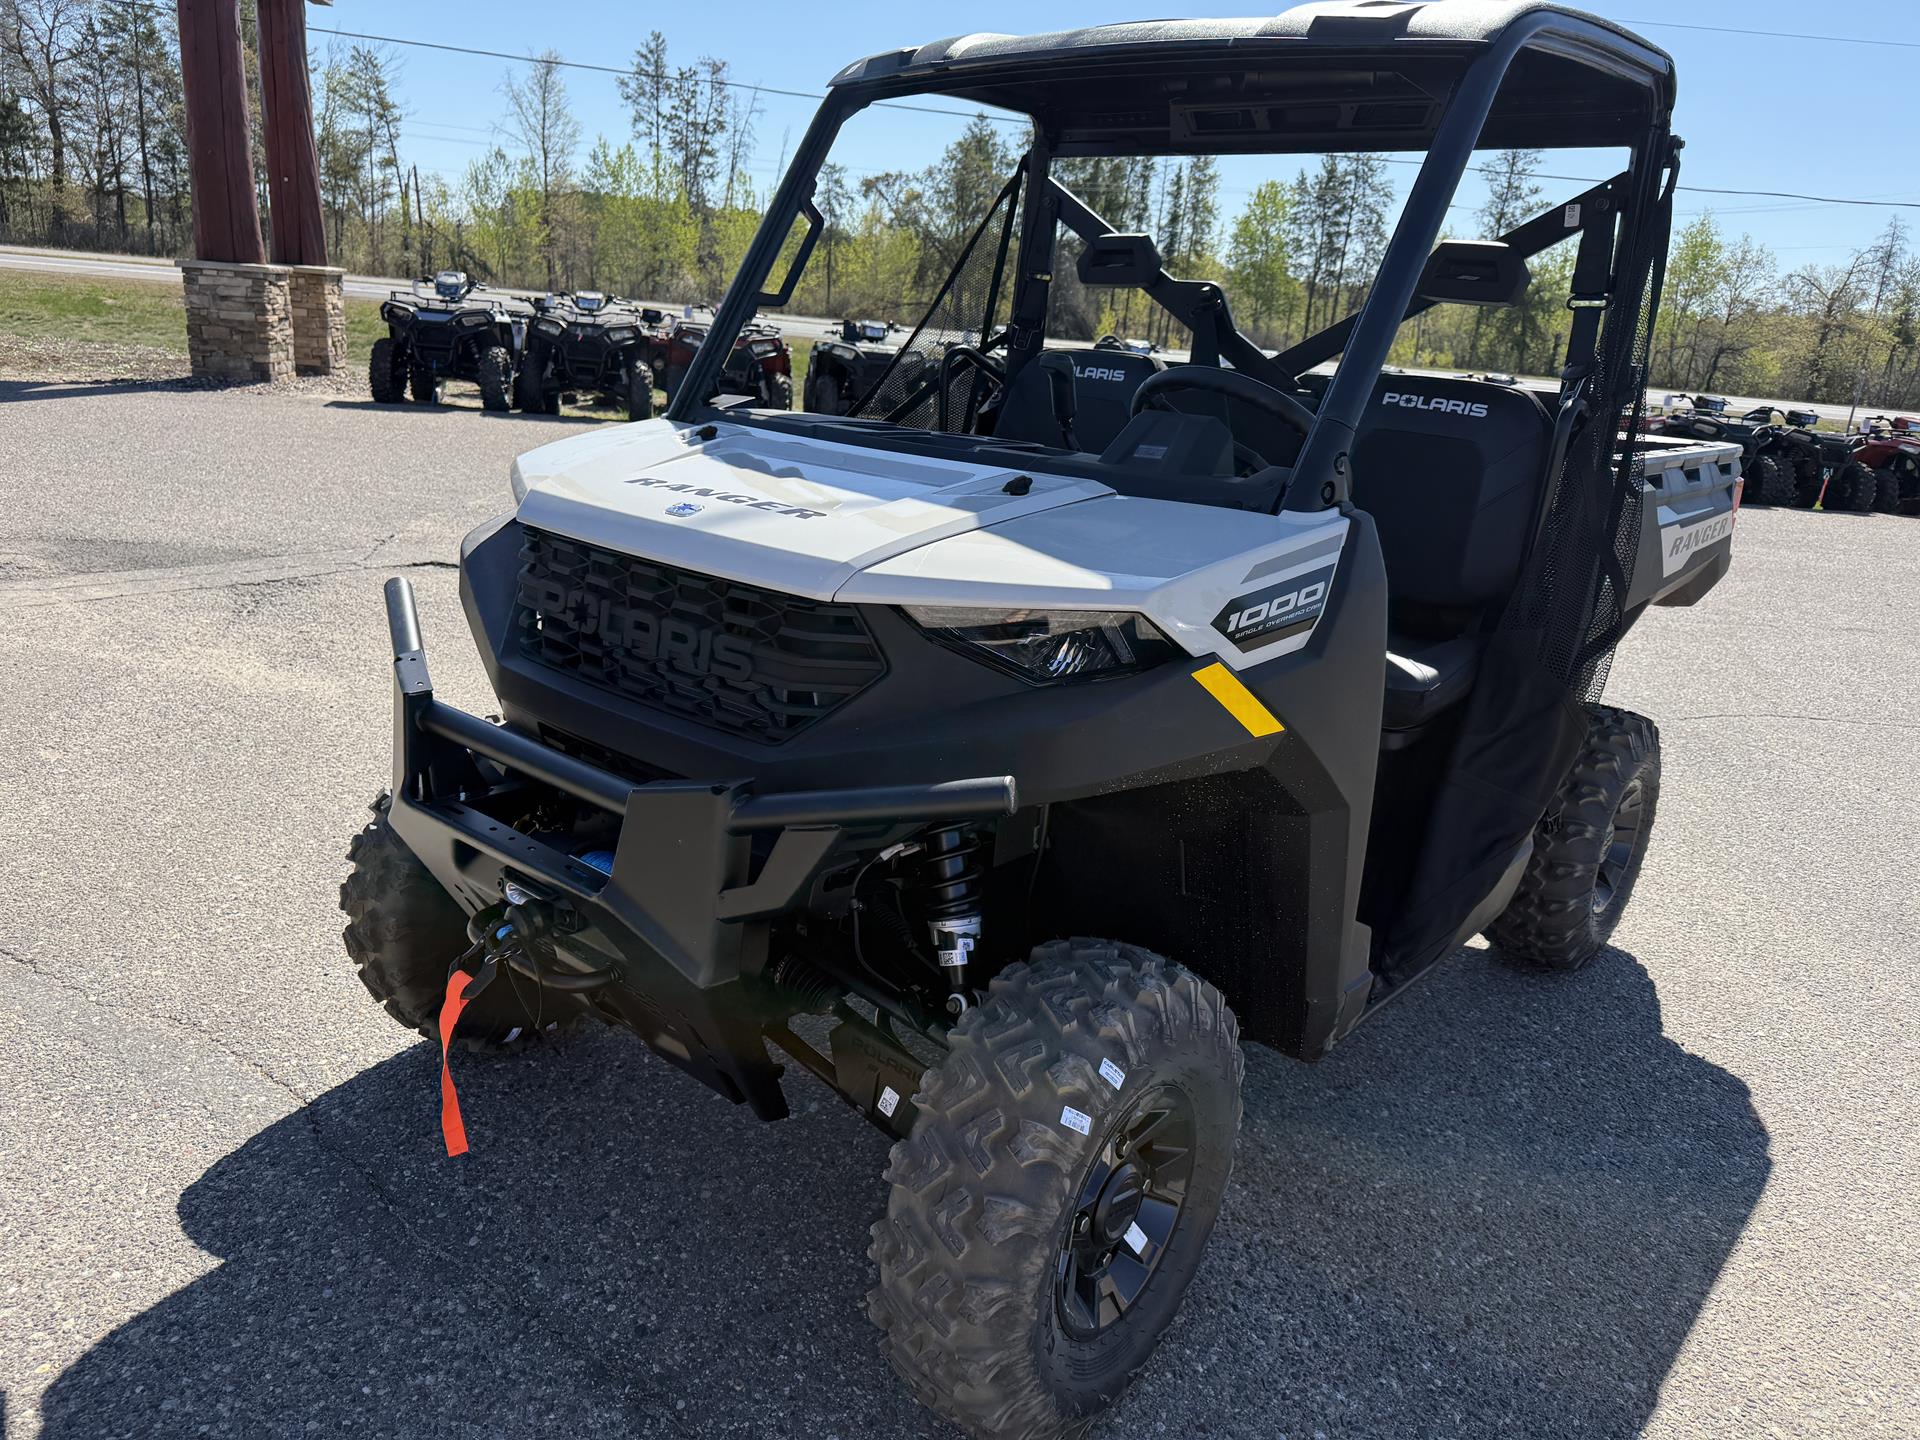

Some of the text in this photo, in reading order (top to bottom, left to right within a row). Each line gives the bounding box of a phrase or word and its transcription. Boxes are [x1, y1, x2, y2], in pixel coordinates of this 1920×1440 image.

[1074, 366, 1126, 381] LARIS
[1382, 392, 1489, 418] POLARIS
[624, 477, 827, 520] RANGER
[1668, 517, 1729, 558] RANGER
[1226, 581, 1325, 633] 1000
[1234, 602, 1322, 639] SINGLE OVERHEAD CAM
[538, 582, 753, 682] POLARIS
[851, 1037, 917, 1082] POLARI
